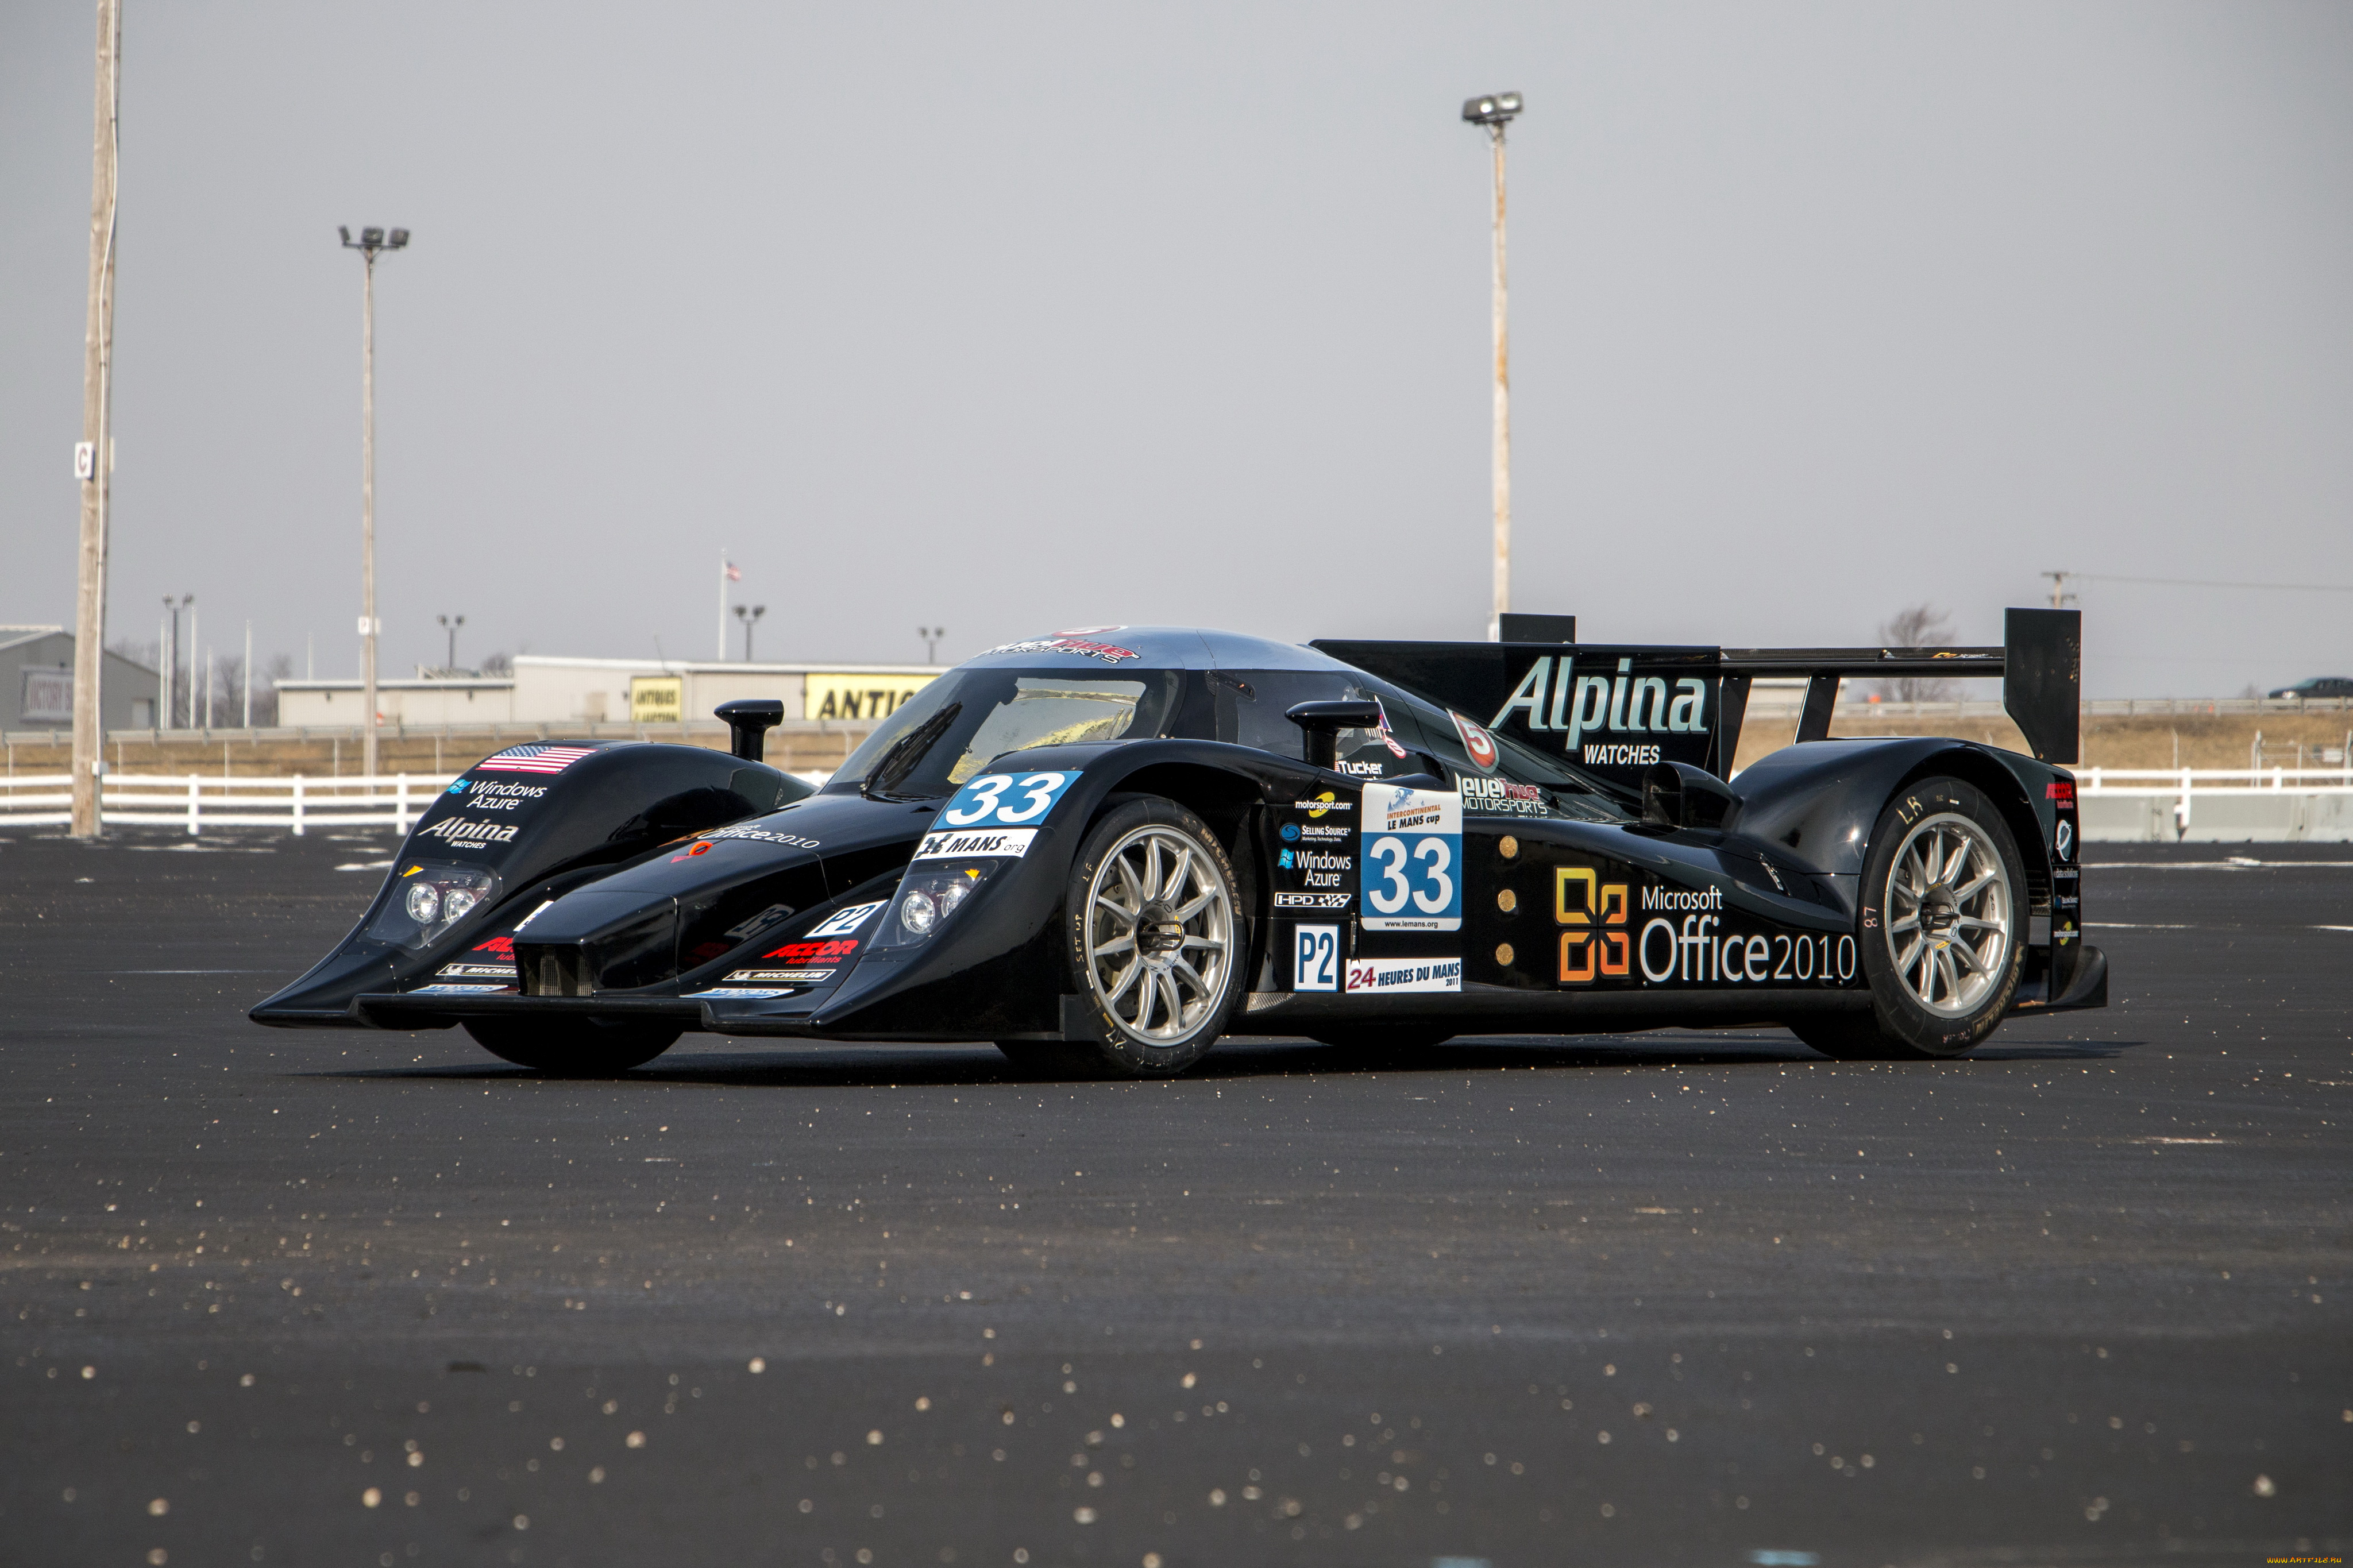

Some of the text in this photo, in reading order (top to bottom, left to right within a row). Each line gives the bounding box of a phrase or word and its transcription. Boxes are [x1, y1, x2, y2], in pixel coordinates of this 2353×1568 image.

[78, 447, 87, 474] C
[635, 690, 676, 706] ANTIQUES
[1488, 656, 1708, 751] Alpina
[1459, 720, 1491, 755] 5
[1584, 744, 1660, 764] WATCHES
[1338, 760, 1382, 774] Tucker
[469, 780, 547, 798] Windows
[466, 794, 519, 810] Azure
[946, 773, 1066, 825] 33
[1295, 800, 1351, 812] motorsport.com
[1462, 797, 1548, 814] MOTORSPORTS
[1387, 805, 1441, 820] INTERCONTINENTAL
[1896, 796, 1923, 825] LR
[417, 817, 519, 843] Alpina
[1302, 825, 1348, 836] SELLING SOURCE
[1387, 814, 1440, 831] LE MANS cup
[451, 840, 487, 849] WATCHES
[697, 828, 820, 848] Office 2010
[946, 836, 1008, 853] MANS
[1296, 851, 1351, 870] Windows
[1305, 870, 1340, 886] Azure
[1369, 836, 1453, 914] 33
[1279, 895, 1314, 905] HPD
[1642, 885, 1722, 910] Microsoft
[813, 905, 877, 933] P2
[1384, 920, 1438, 929] www.lemans.org
[762, 940, 859, 958] ACCOR
[1075, 937, 1085, 963] SET
[1640, 914, 1857, 983] Office 2010
[786, 956, 842, 964] lubrifiants
[1163, 955, 1179, 972] RACING
[1298, 932, 1334, 984] P2
[1347, 962, 1460, 991] 24 HEURES DU MANS
[1445, 977, 1459, 987] 2011
